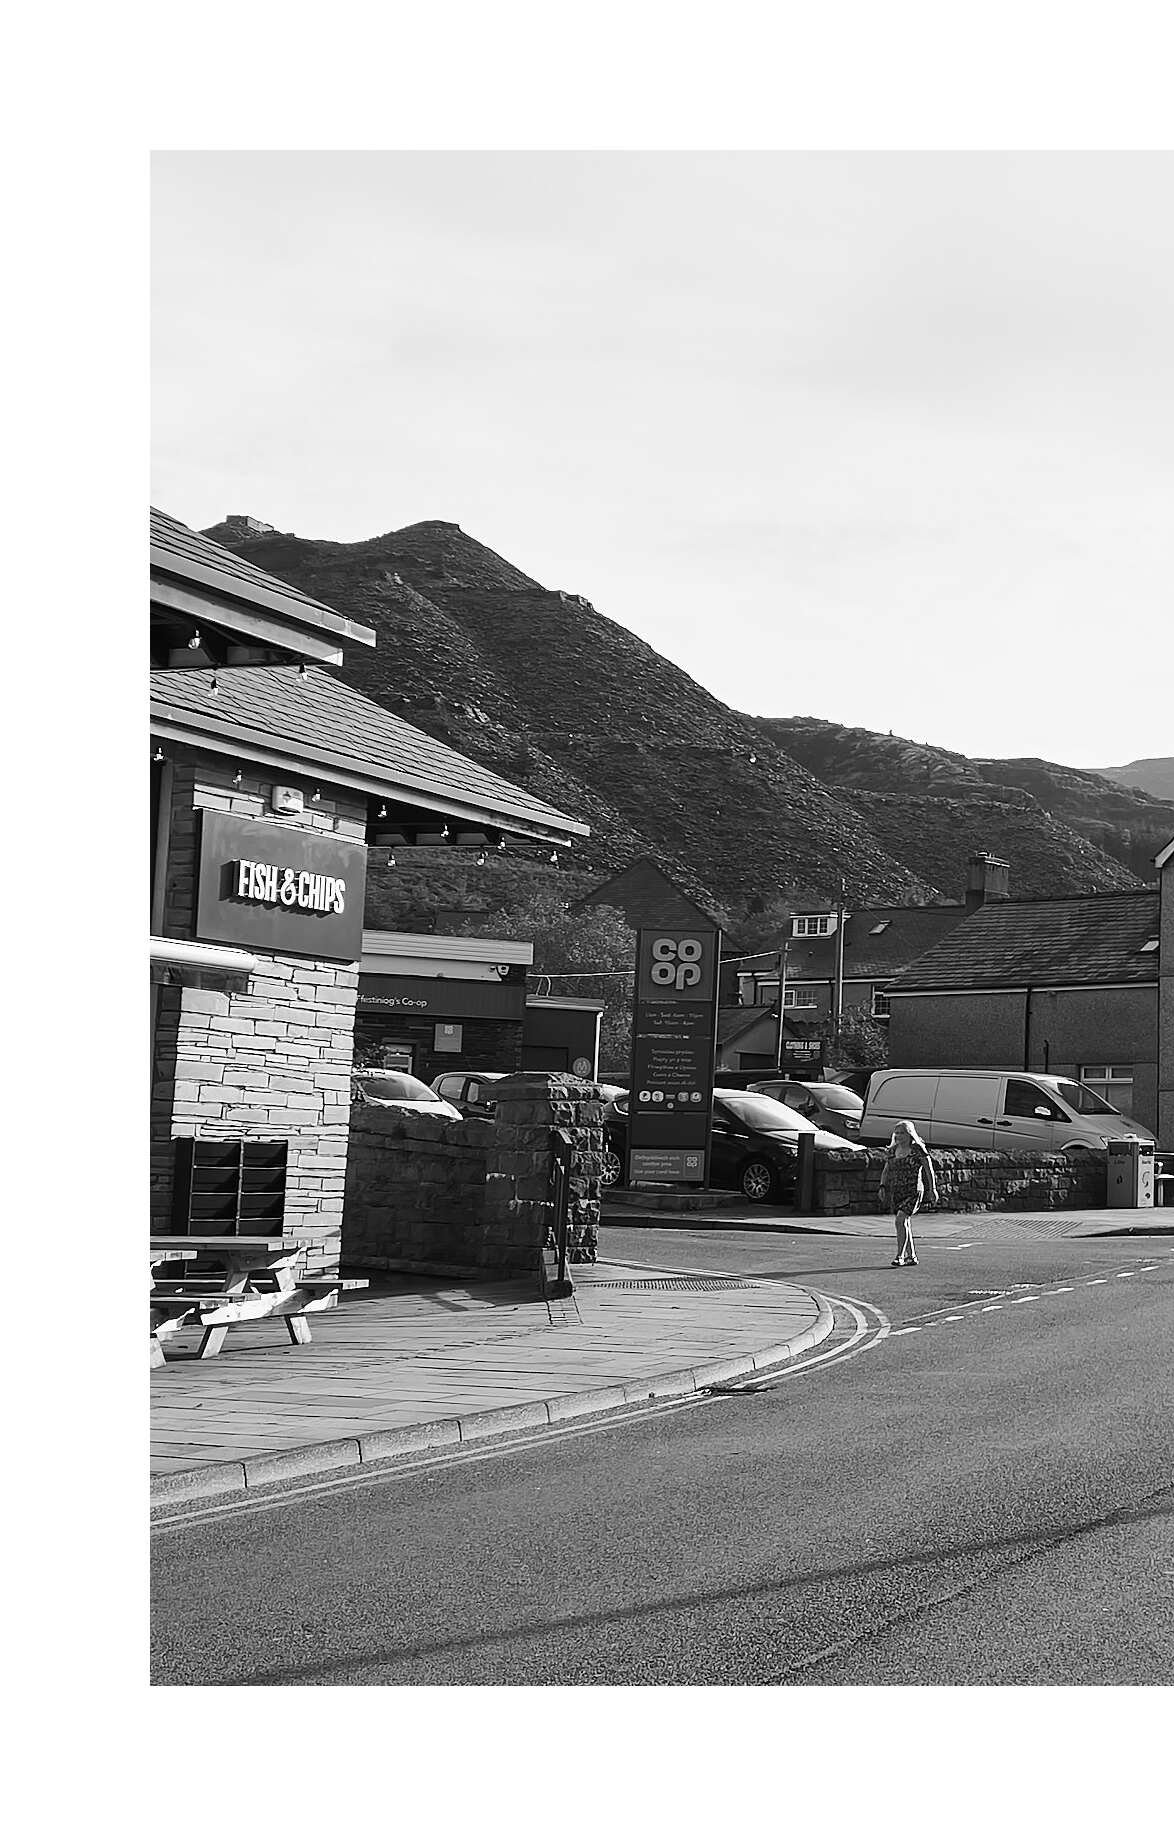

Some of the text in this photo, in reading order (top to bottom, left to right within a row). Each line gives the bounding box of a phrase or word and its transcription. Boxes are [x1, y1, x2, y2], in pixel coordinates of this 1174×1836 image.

[238, 859, 346, 914] FISH & CHIPS
[401, 997, 428, 1008] Co-op
